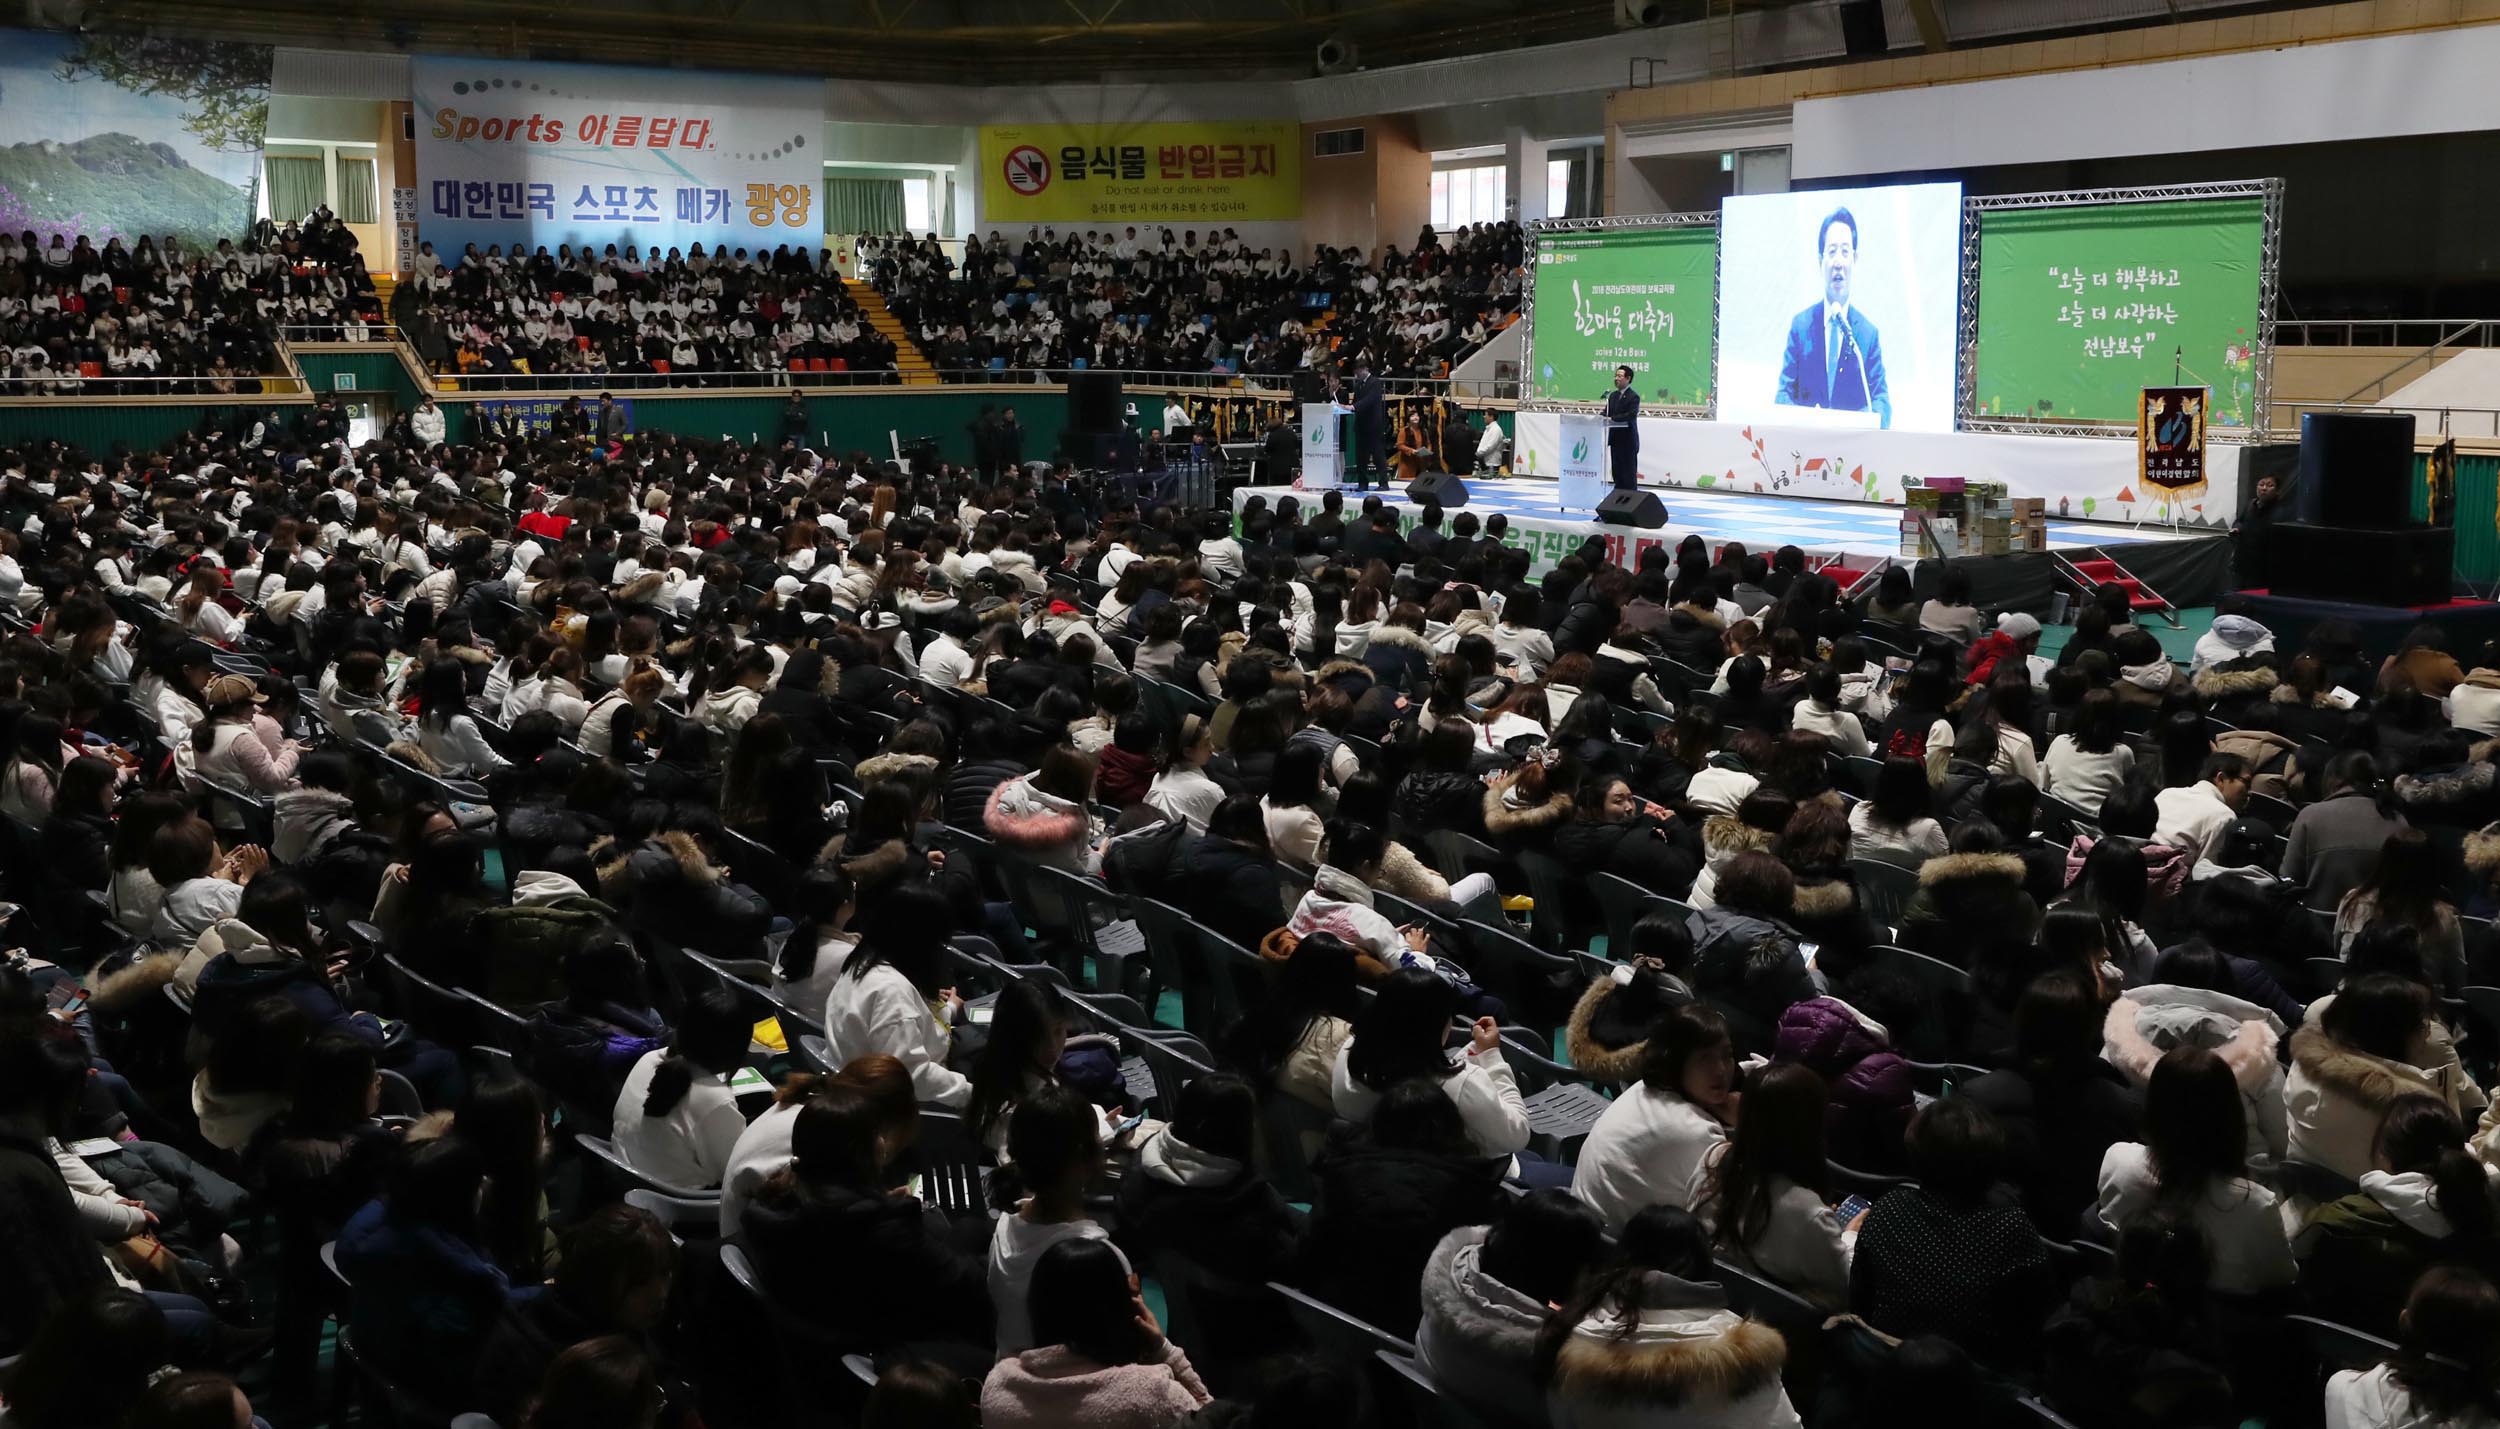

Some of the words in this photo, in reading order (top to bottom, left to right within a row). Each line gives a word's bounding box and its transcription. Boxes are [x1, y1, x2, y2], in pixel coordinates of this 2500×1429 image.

[432, 107, 565, 144] Sports
[577, 114, 717, 152] 아름답다.
[1060, 145, 1147, 180] 음식물
[1158, 143, 1277, 179] 반입금지
[432, 179, 556, 222] 대한민국
[572, 184, 661, 224] 스포츠
[676, 186, 733, 225] 메카
[745, 182, 811, 228] 광양
[1105, 185, 1121, 196] Do
[1124, 186, 1140, 195] not
[1143, 186, 1160, 195] eat
[1163, 186, 1174, 195] or
[1177, 185, 1202, 195] drink
[1207, 185, 1230, 194] here
[2092, 272, 2108, 287] 더
[2115, 266, 2181, 293] 행복하고
[1572, 279, 1624, 340] 한마음
[1628, 300, 1674, 343] 대축제
[2057, 300, 2087, 327] 오늘
[2092, 306, 2107, 320] 더
[2114, 303, 2179, 327] 사랑하는
